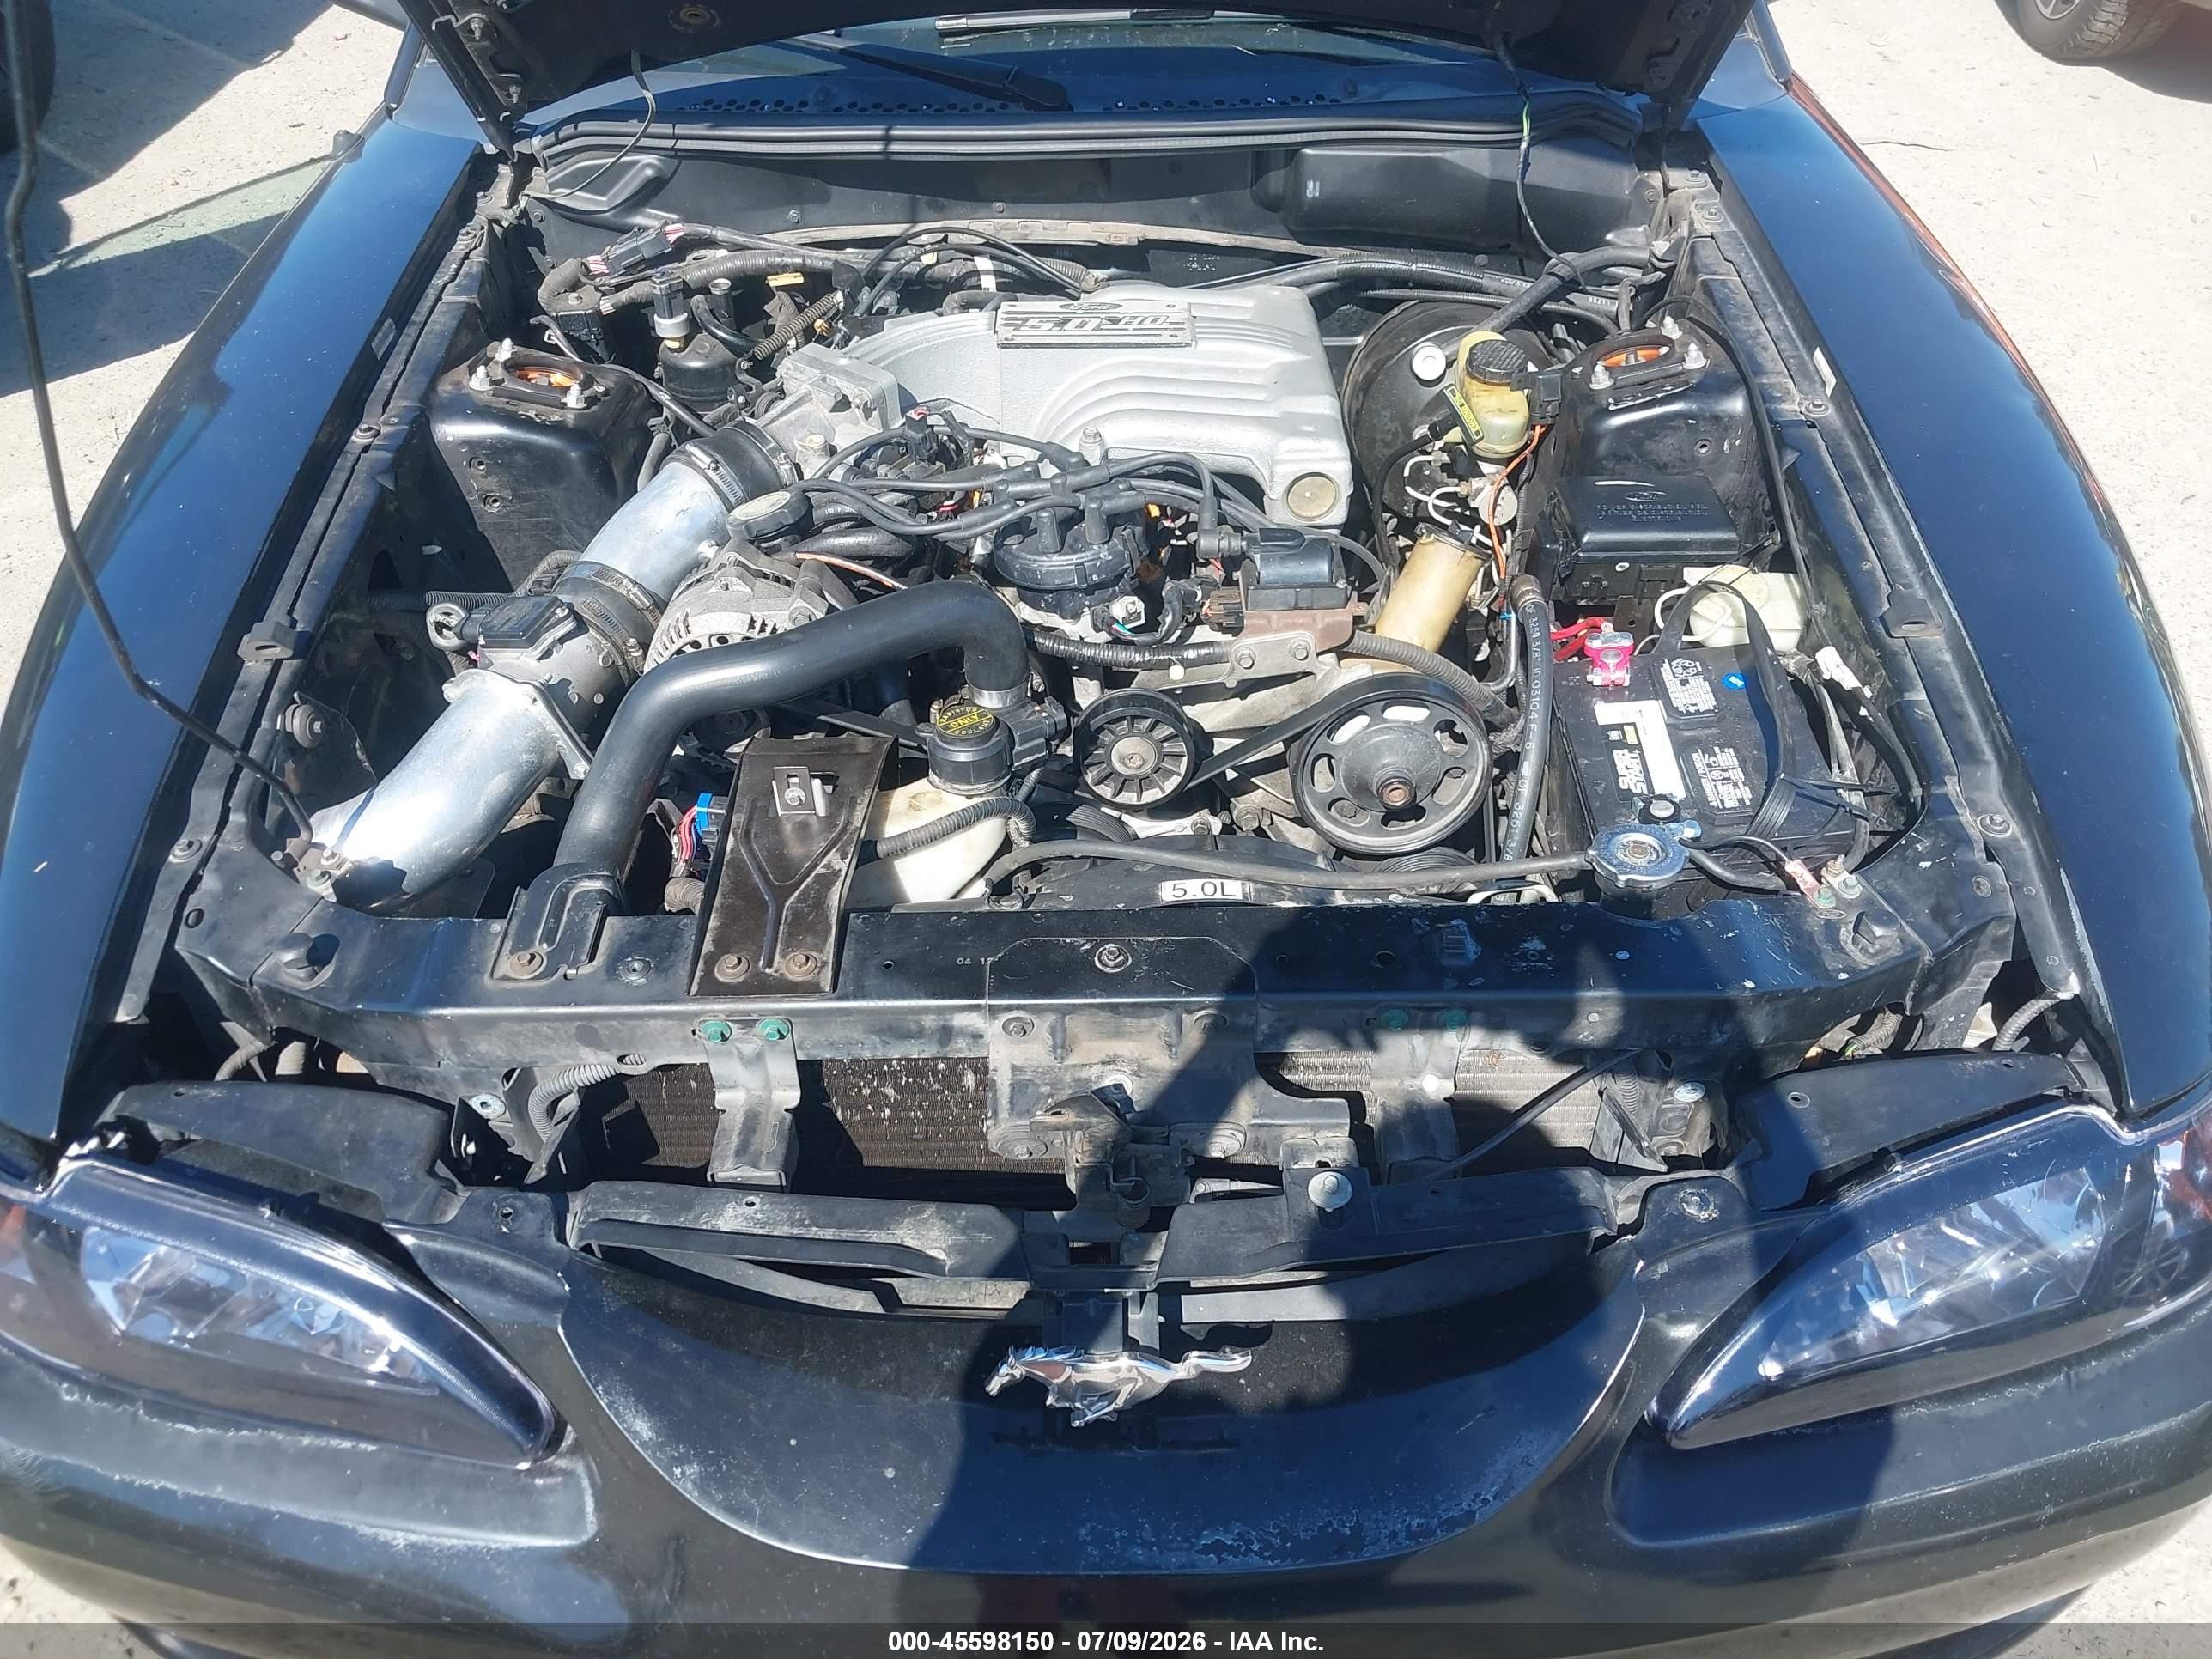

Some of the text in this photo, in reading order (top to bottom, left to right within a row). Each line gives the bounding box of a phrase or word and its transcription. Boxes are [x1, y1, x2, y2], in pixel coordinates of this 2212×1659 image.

[1019, 318, 1100, 331] 5.0
[1528, 681, 1542, 720] 03104
[939, 708, 978, 723] RADIATOR
[950, 714, 980, 728] ONLY
[954, 720, 991, 735] COOLANT
[1613, 749, 1630, 790] SUPER
[1171, 881, 1237, 898] 5.0L
